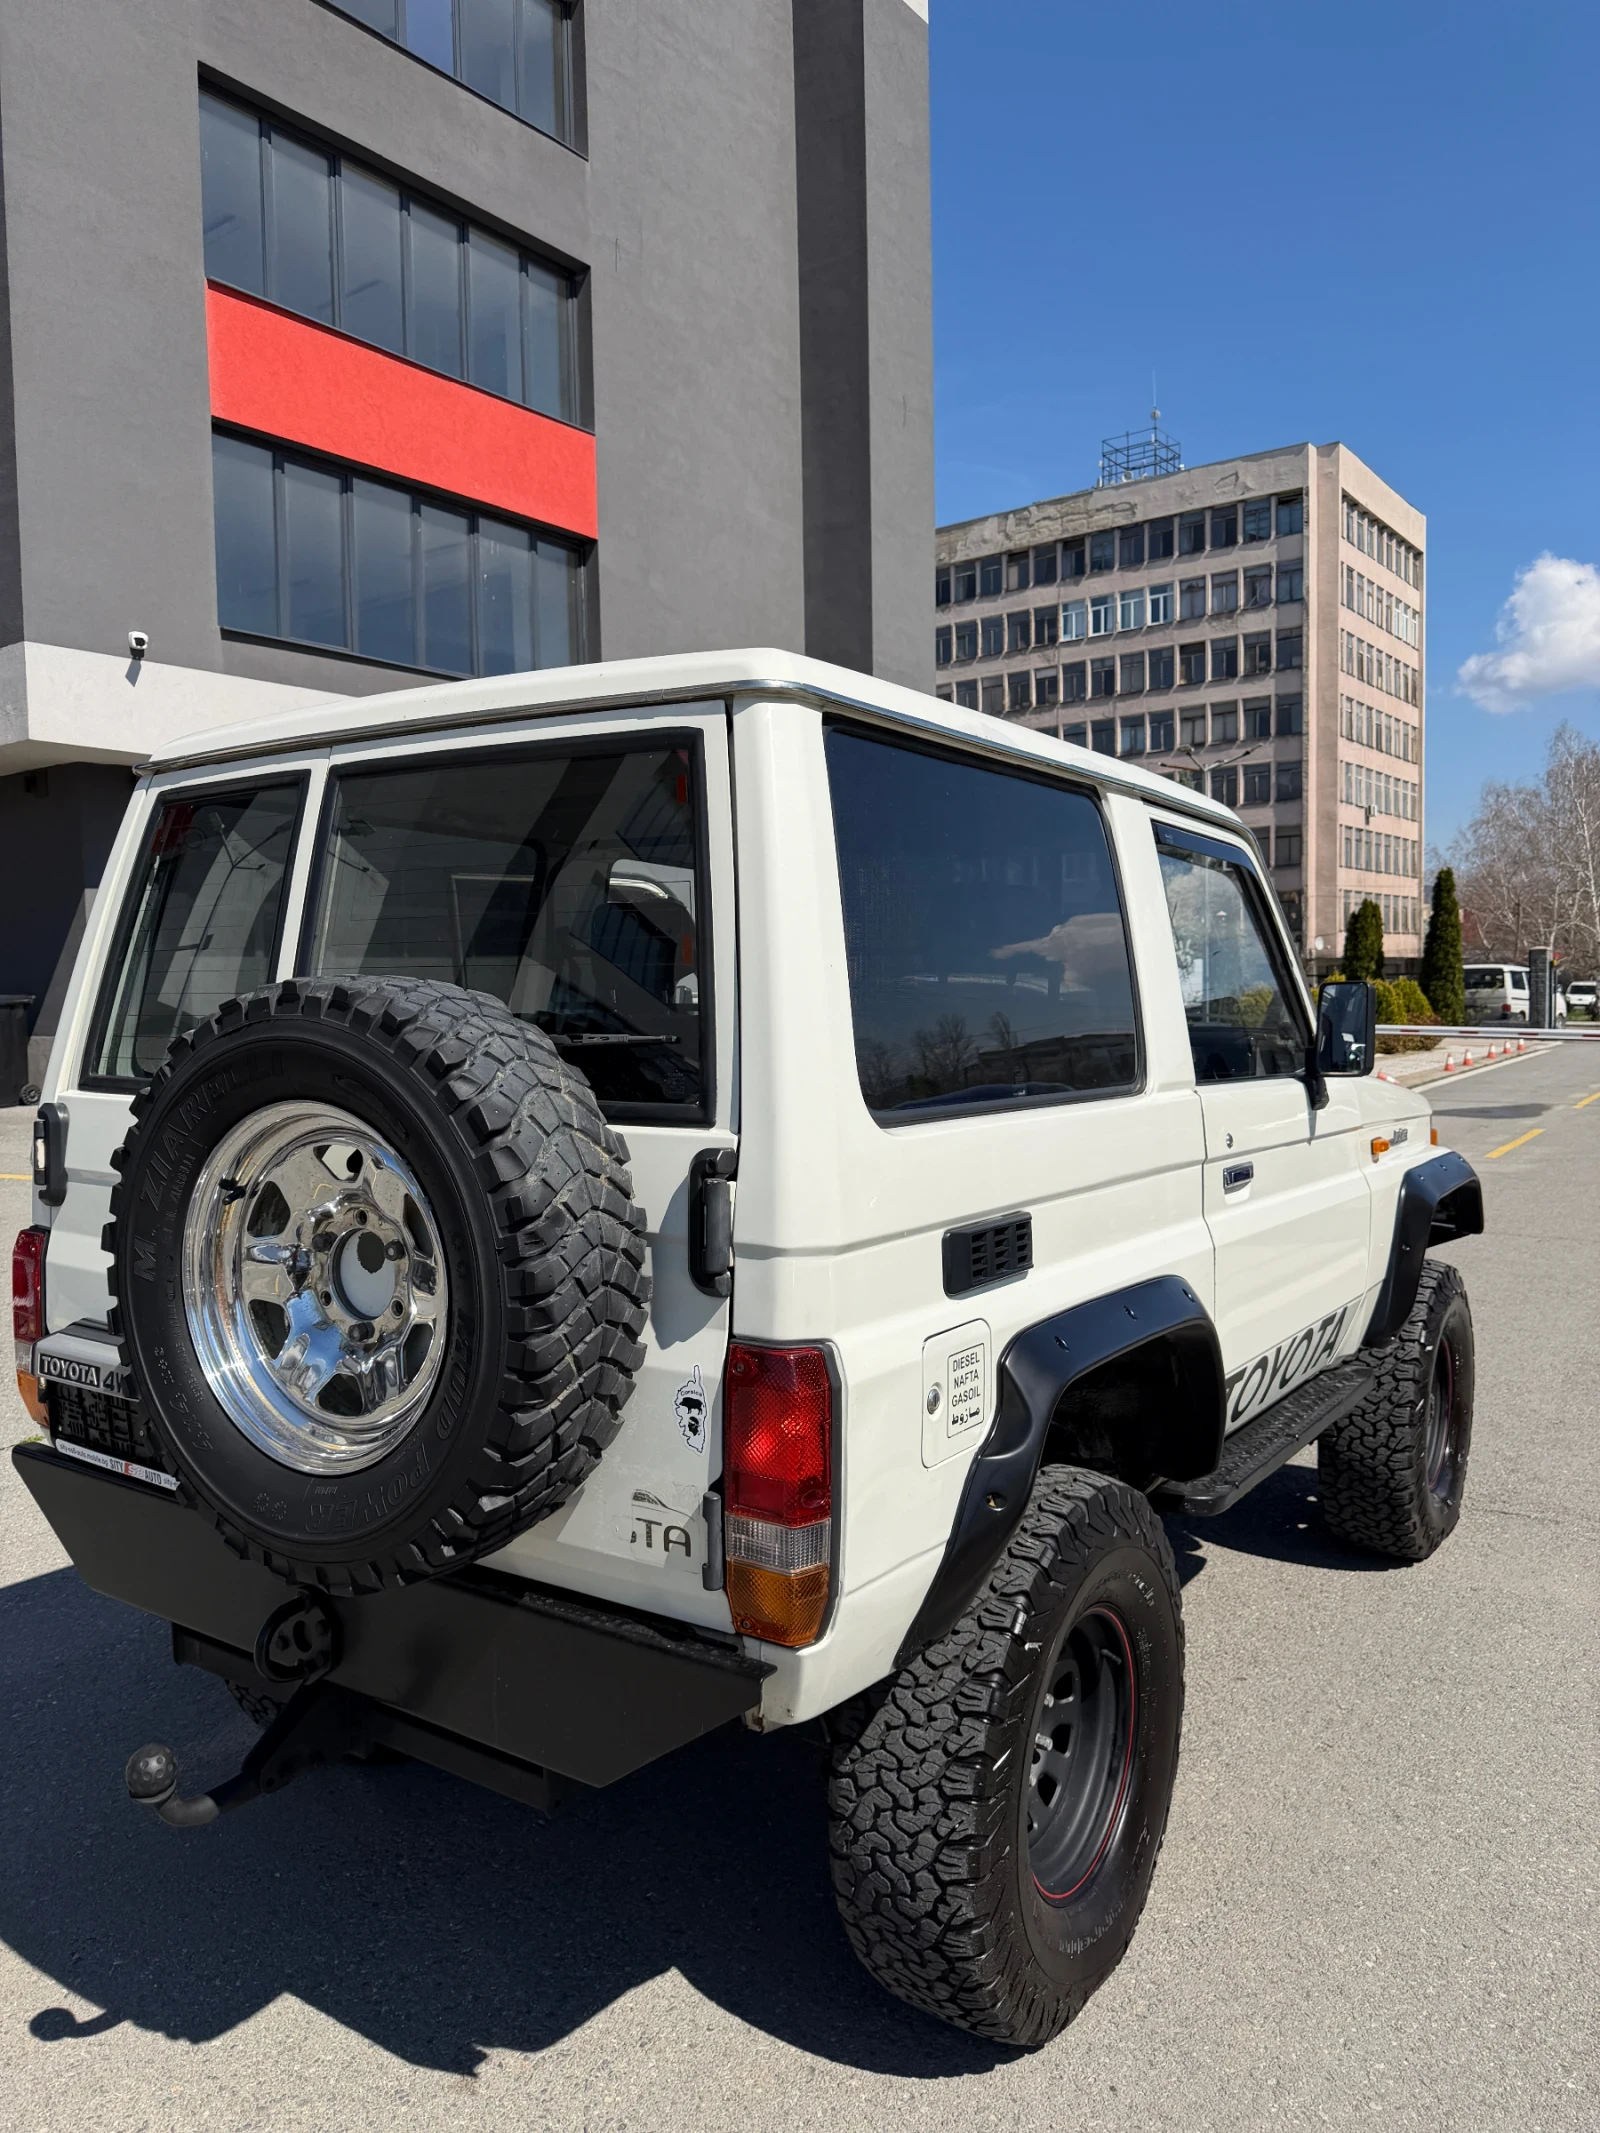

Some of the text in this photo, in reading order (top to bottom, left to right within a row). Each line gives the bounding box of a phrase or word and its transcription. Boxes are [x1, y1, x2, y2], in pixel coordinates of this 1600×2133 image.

[41, 1356, 99, 1386] TOYOTA
[952, 1351, 981, 1373] DIESEL
[953, 1368, 980, 1390] NAFTA
[951, 1385, 981, 1408] GASOIL
[145, 1469, 162, 1485] AUTO
[305, 1442, 432, 1535] POWER
[630, 1517, 691, 1557] TA
